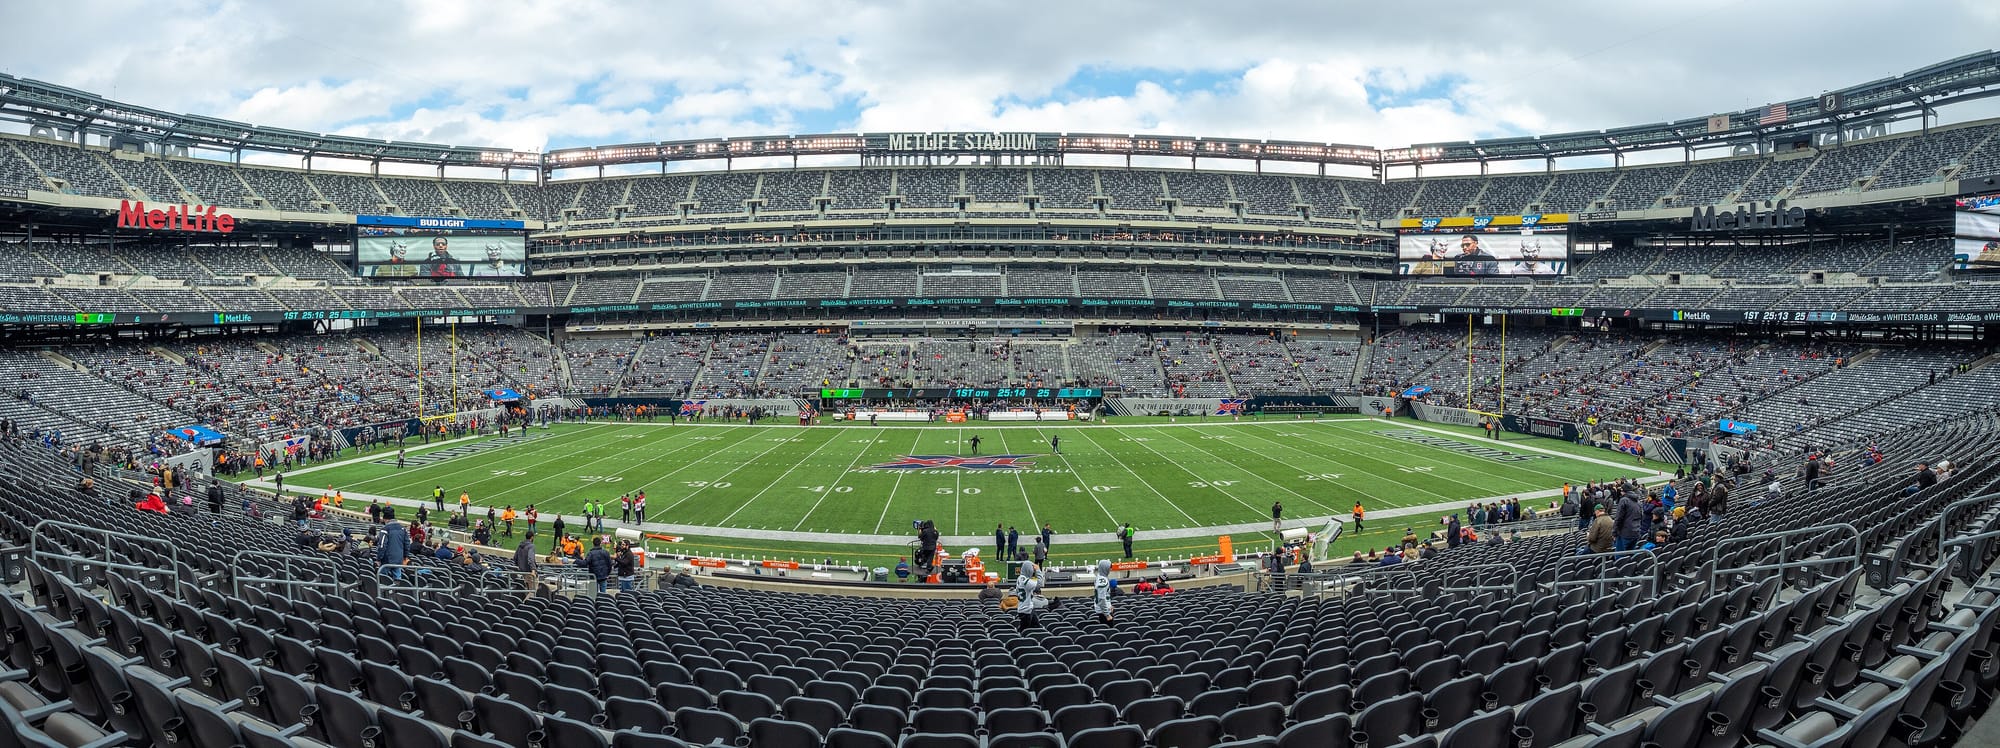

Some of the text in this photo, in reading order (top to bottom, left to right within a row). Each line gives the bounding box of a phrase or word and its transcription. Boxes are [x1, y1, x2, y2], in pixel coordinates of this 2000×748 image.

[889, 133, 1036, 150] METLIFE STADIUM
[117, 199, 235, 233] MetLife
[1690, 198, 1806, 231] MetLife
[420, 219, 465, 228] BUD LIGHT
[1422, 219, 1437, 228] SAP
[1473, 217, 1490, 226] SAP
[1522, 216, 1538, 226] SAP
[98, 314, 104, 322] 0
[284, 312, 298, 320] 1ST
[302, 312, 324, 320] 25:16
[1684, 312, 1711, 321] MetLife
[1743, 311, 1759, 320] 1ST
[1763, 312, 1788, 320] 25:13
[1795, 312, 1806, 321] 25
[1830, 312, 1837, 321] 0
[842, 389, 849, 398] 0
[955, 388, 974, 398] 1ST
[998, 388, 1026, 397] 25:14
[1037, 388, 1050, 397] 25
[1085, 388, 1092, 397] 0
[1531, 420, 1564, 437] GUARDIANS
[808, 485, 853, 493] 40
[935, 487, 981, 495] 50
[1066, 485, 1111, 493] 40
